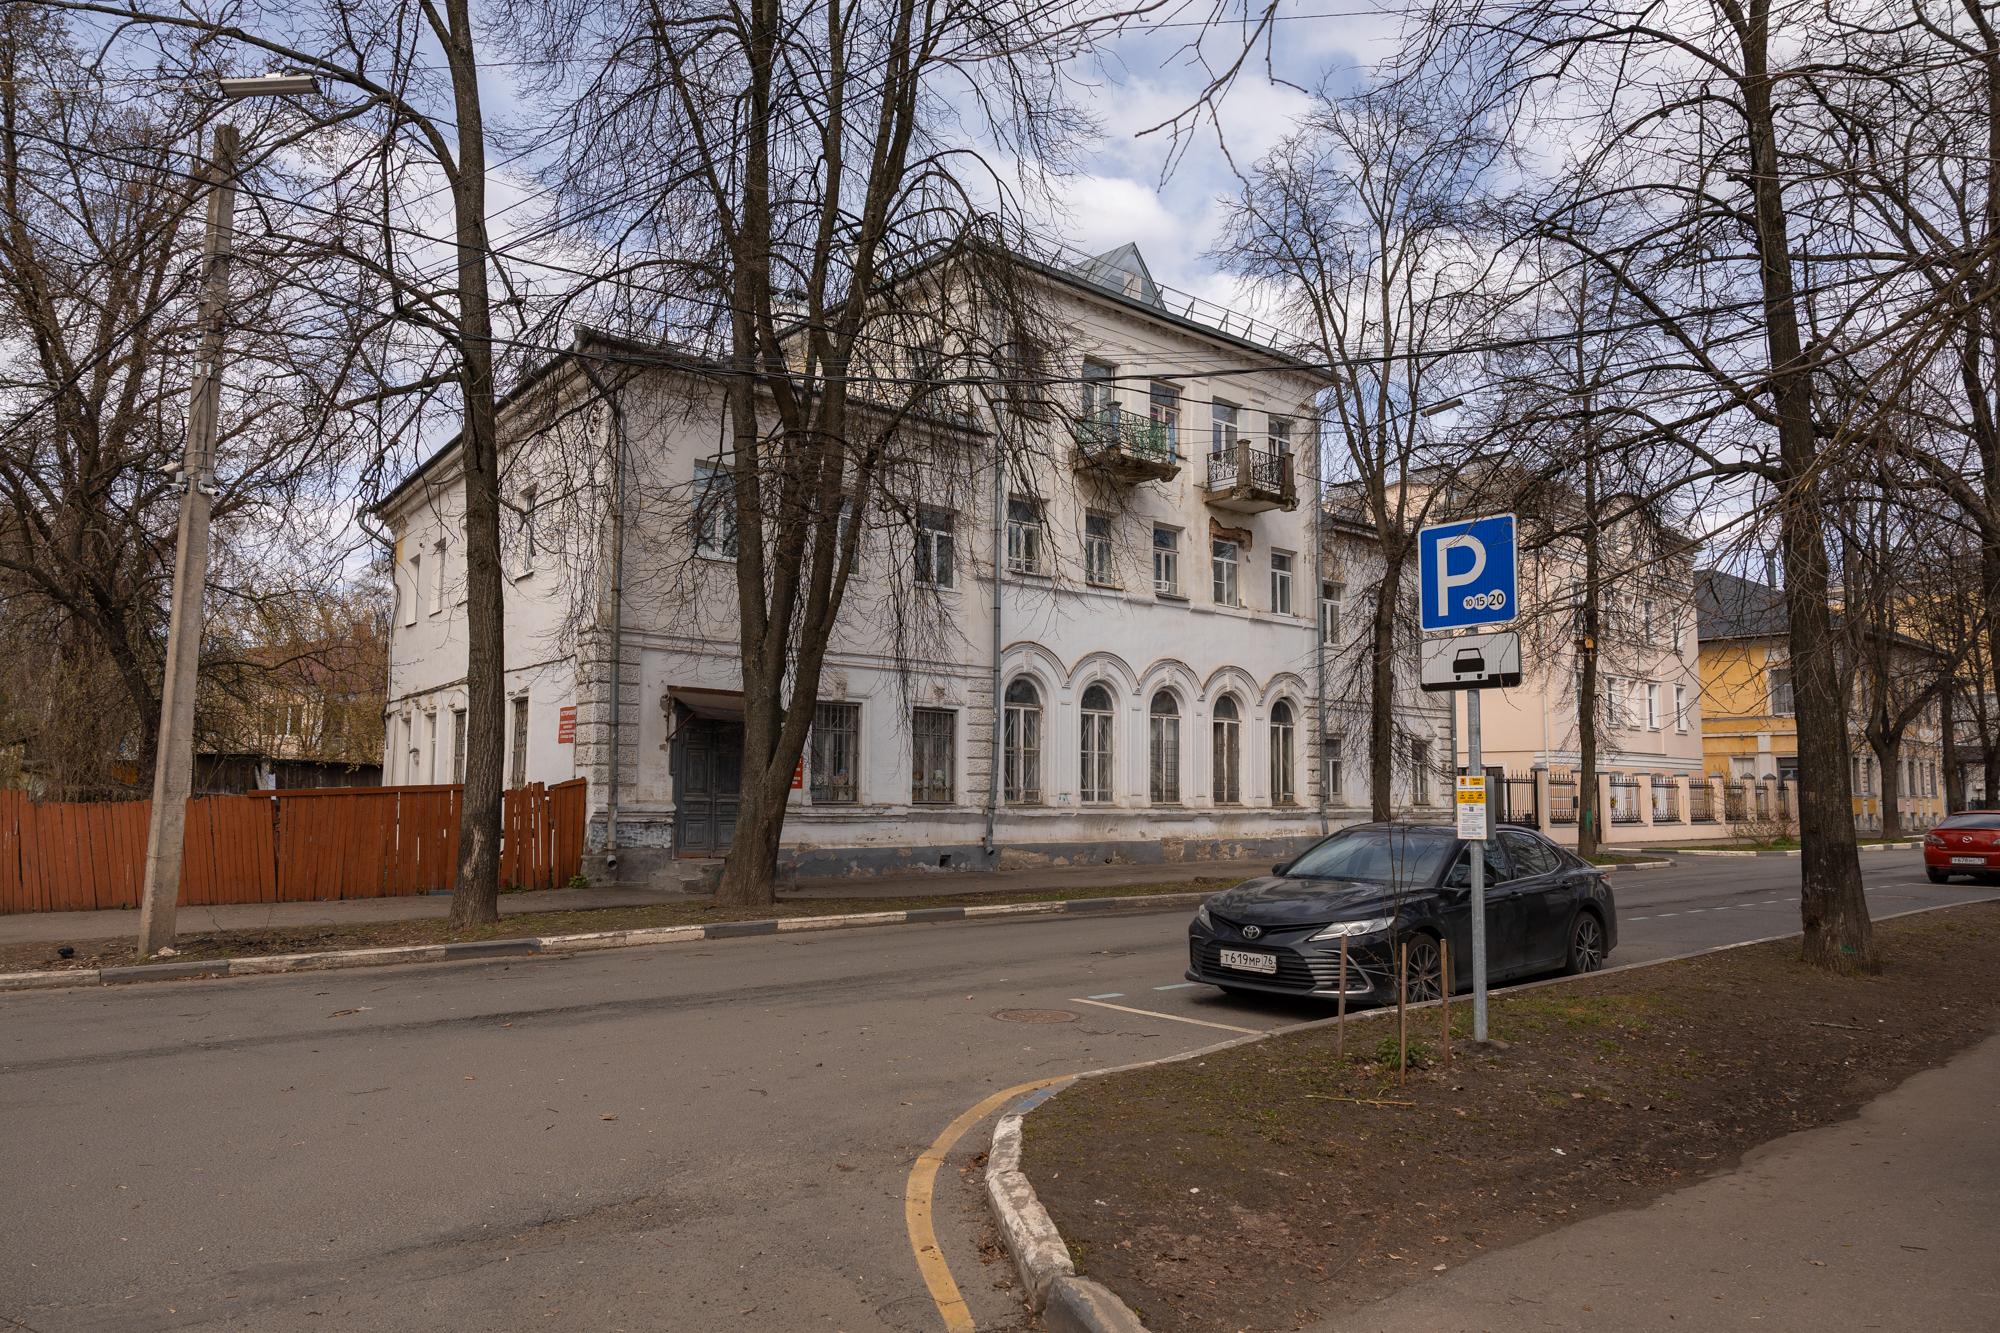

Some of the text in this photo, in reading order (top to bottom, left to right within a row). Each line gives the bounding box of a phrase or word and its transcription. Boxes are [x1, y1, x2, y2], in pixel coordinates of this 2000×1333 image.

[1436, 534, 1487, 617] P
[1465, 593, 1504, 607] 10 15 20
